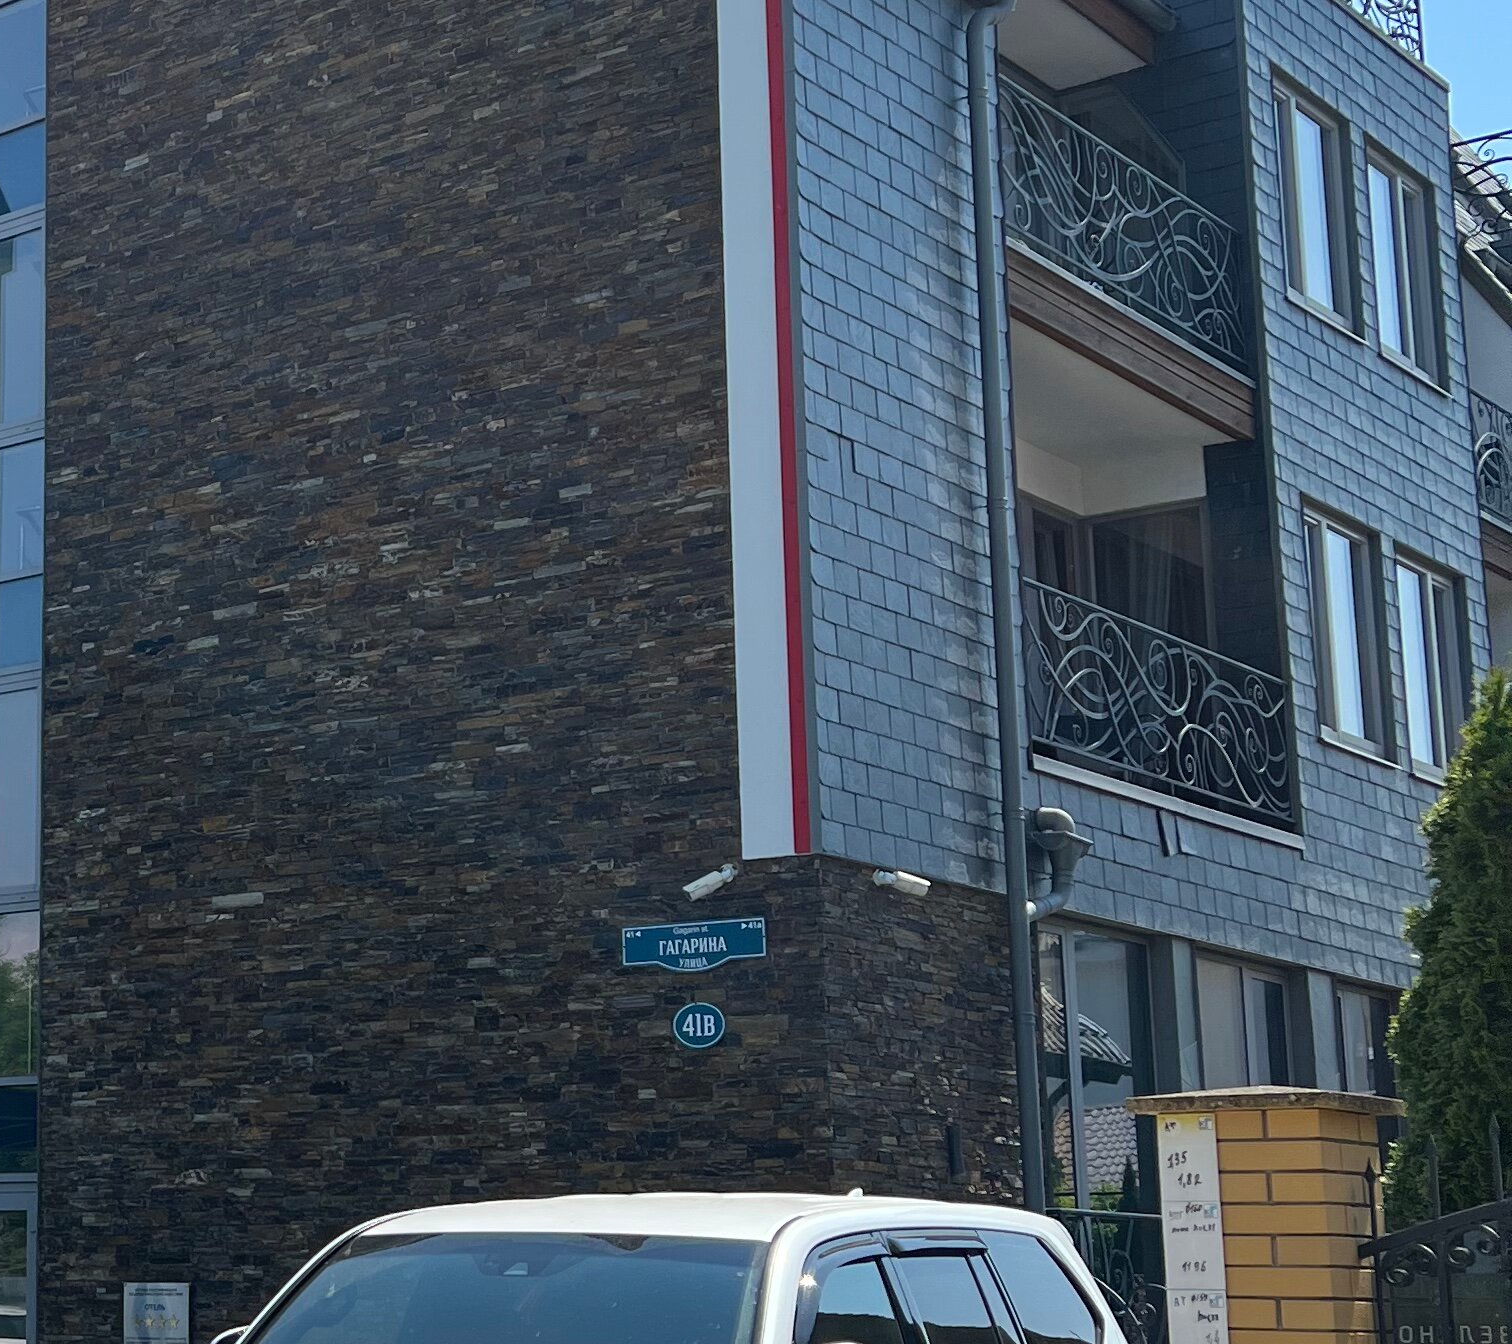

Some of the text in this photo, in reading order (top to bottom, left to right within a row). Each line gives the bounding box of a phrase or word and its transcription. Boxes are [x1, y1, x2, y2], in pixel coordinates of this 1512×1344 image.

[659, 936, 727, 956] ГАГАРИНА
[678, 957, 709, 968] УЛИЦА
[144, 1303, 166, 1311] ОТЕЛЬ
